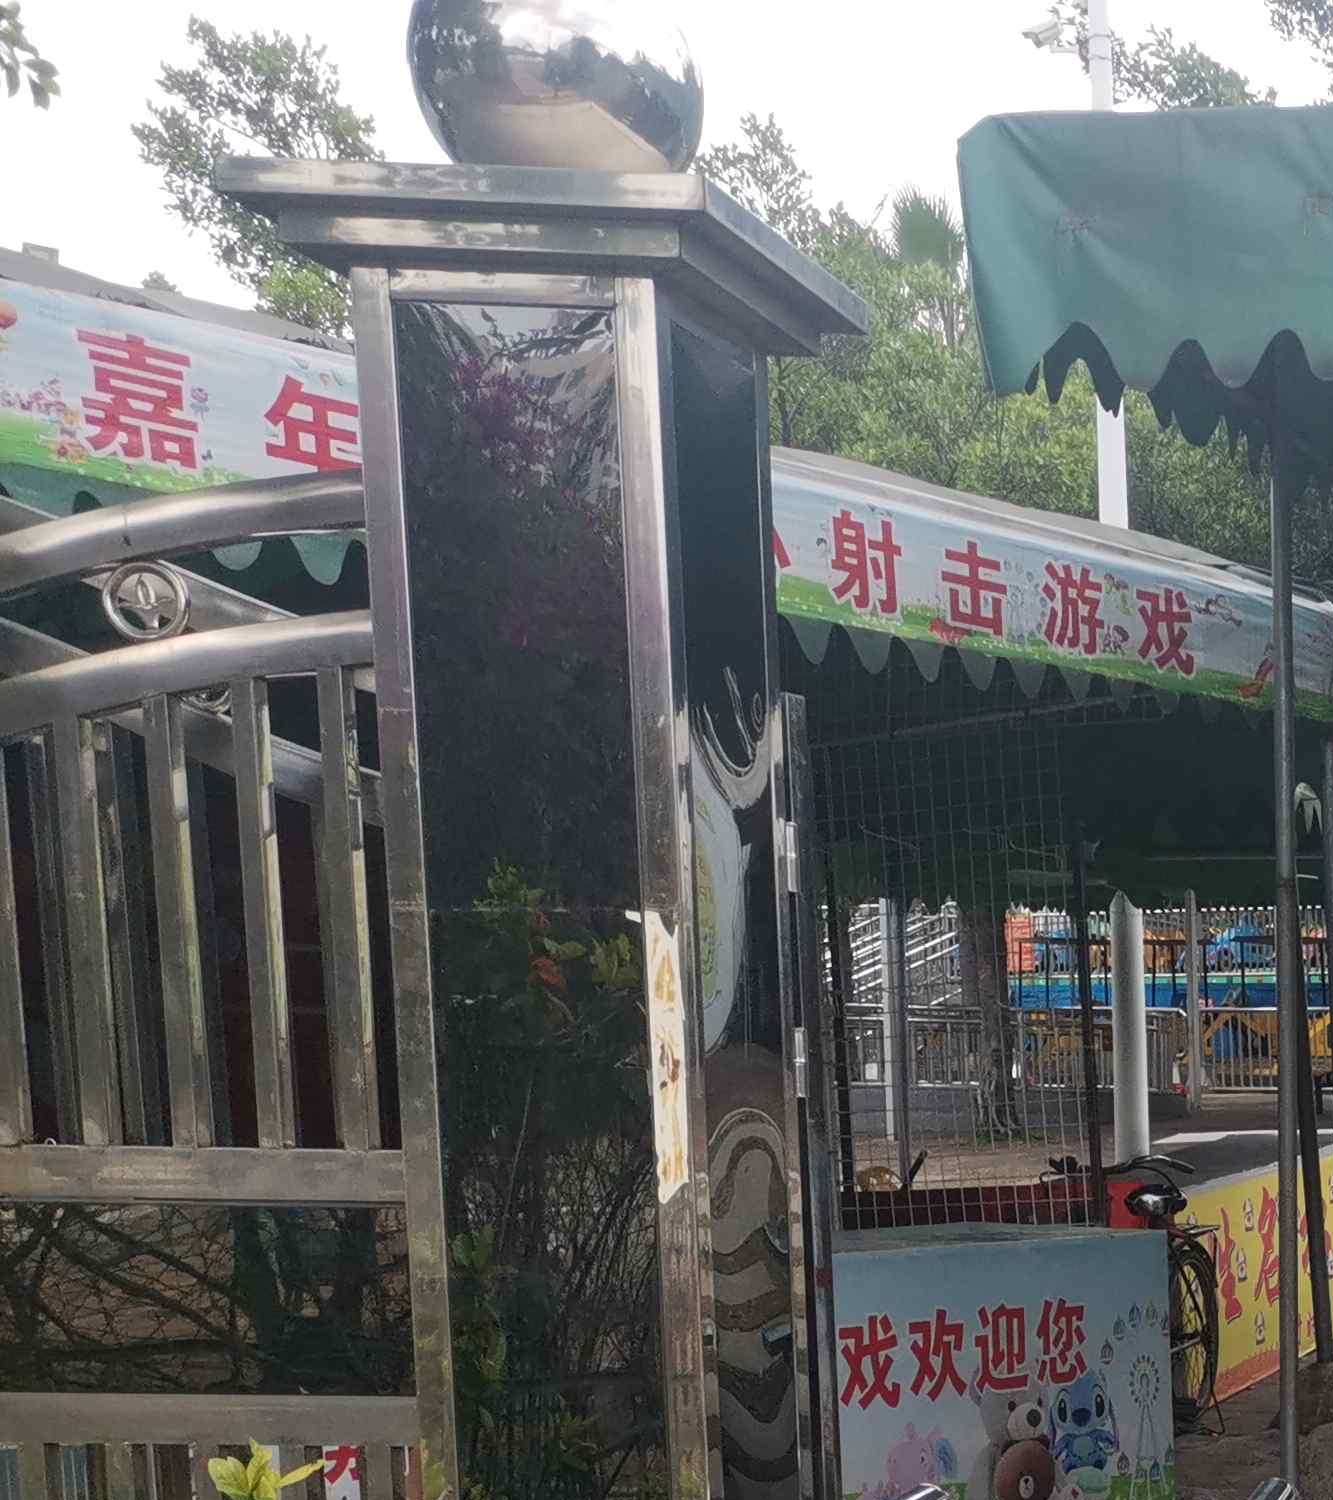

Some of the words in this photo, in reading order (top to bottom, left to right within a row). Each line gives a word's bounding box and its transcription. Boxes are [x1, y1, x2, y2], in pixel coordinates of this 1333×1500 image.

[829, 509, 1197, 677] 射击游戏
[838, 1297, 1088, 1410] 戏欢迎您
